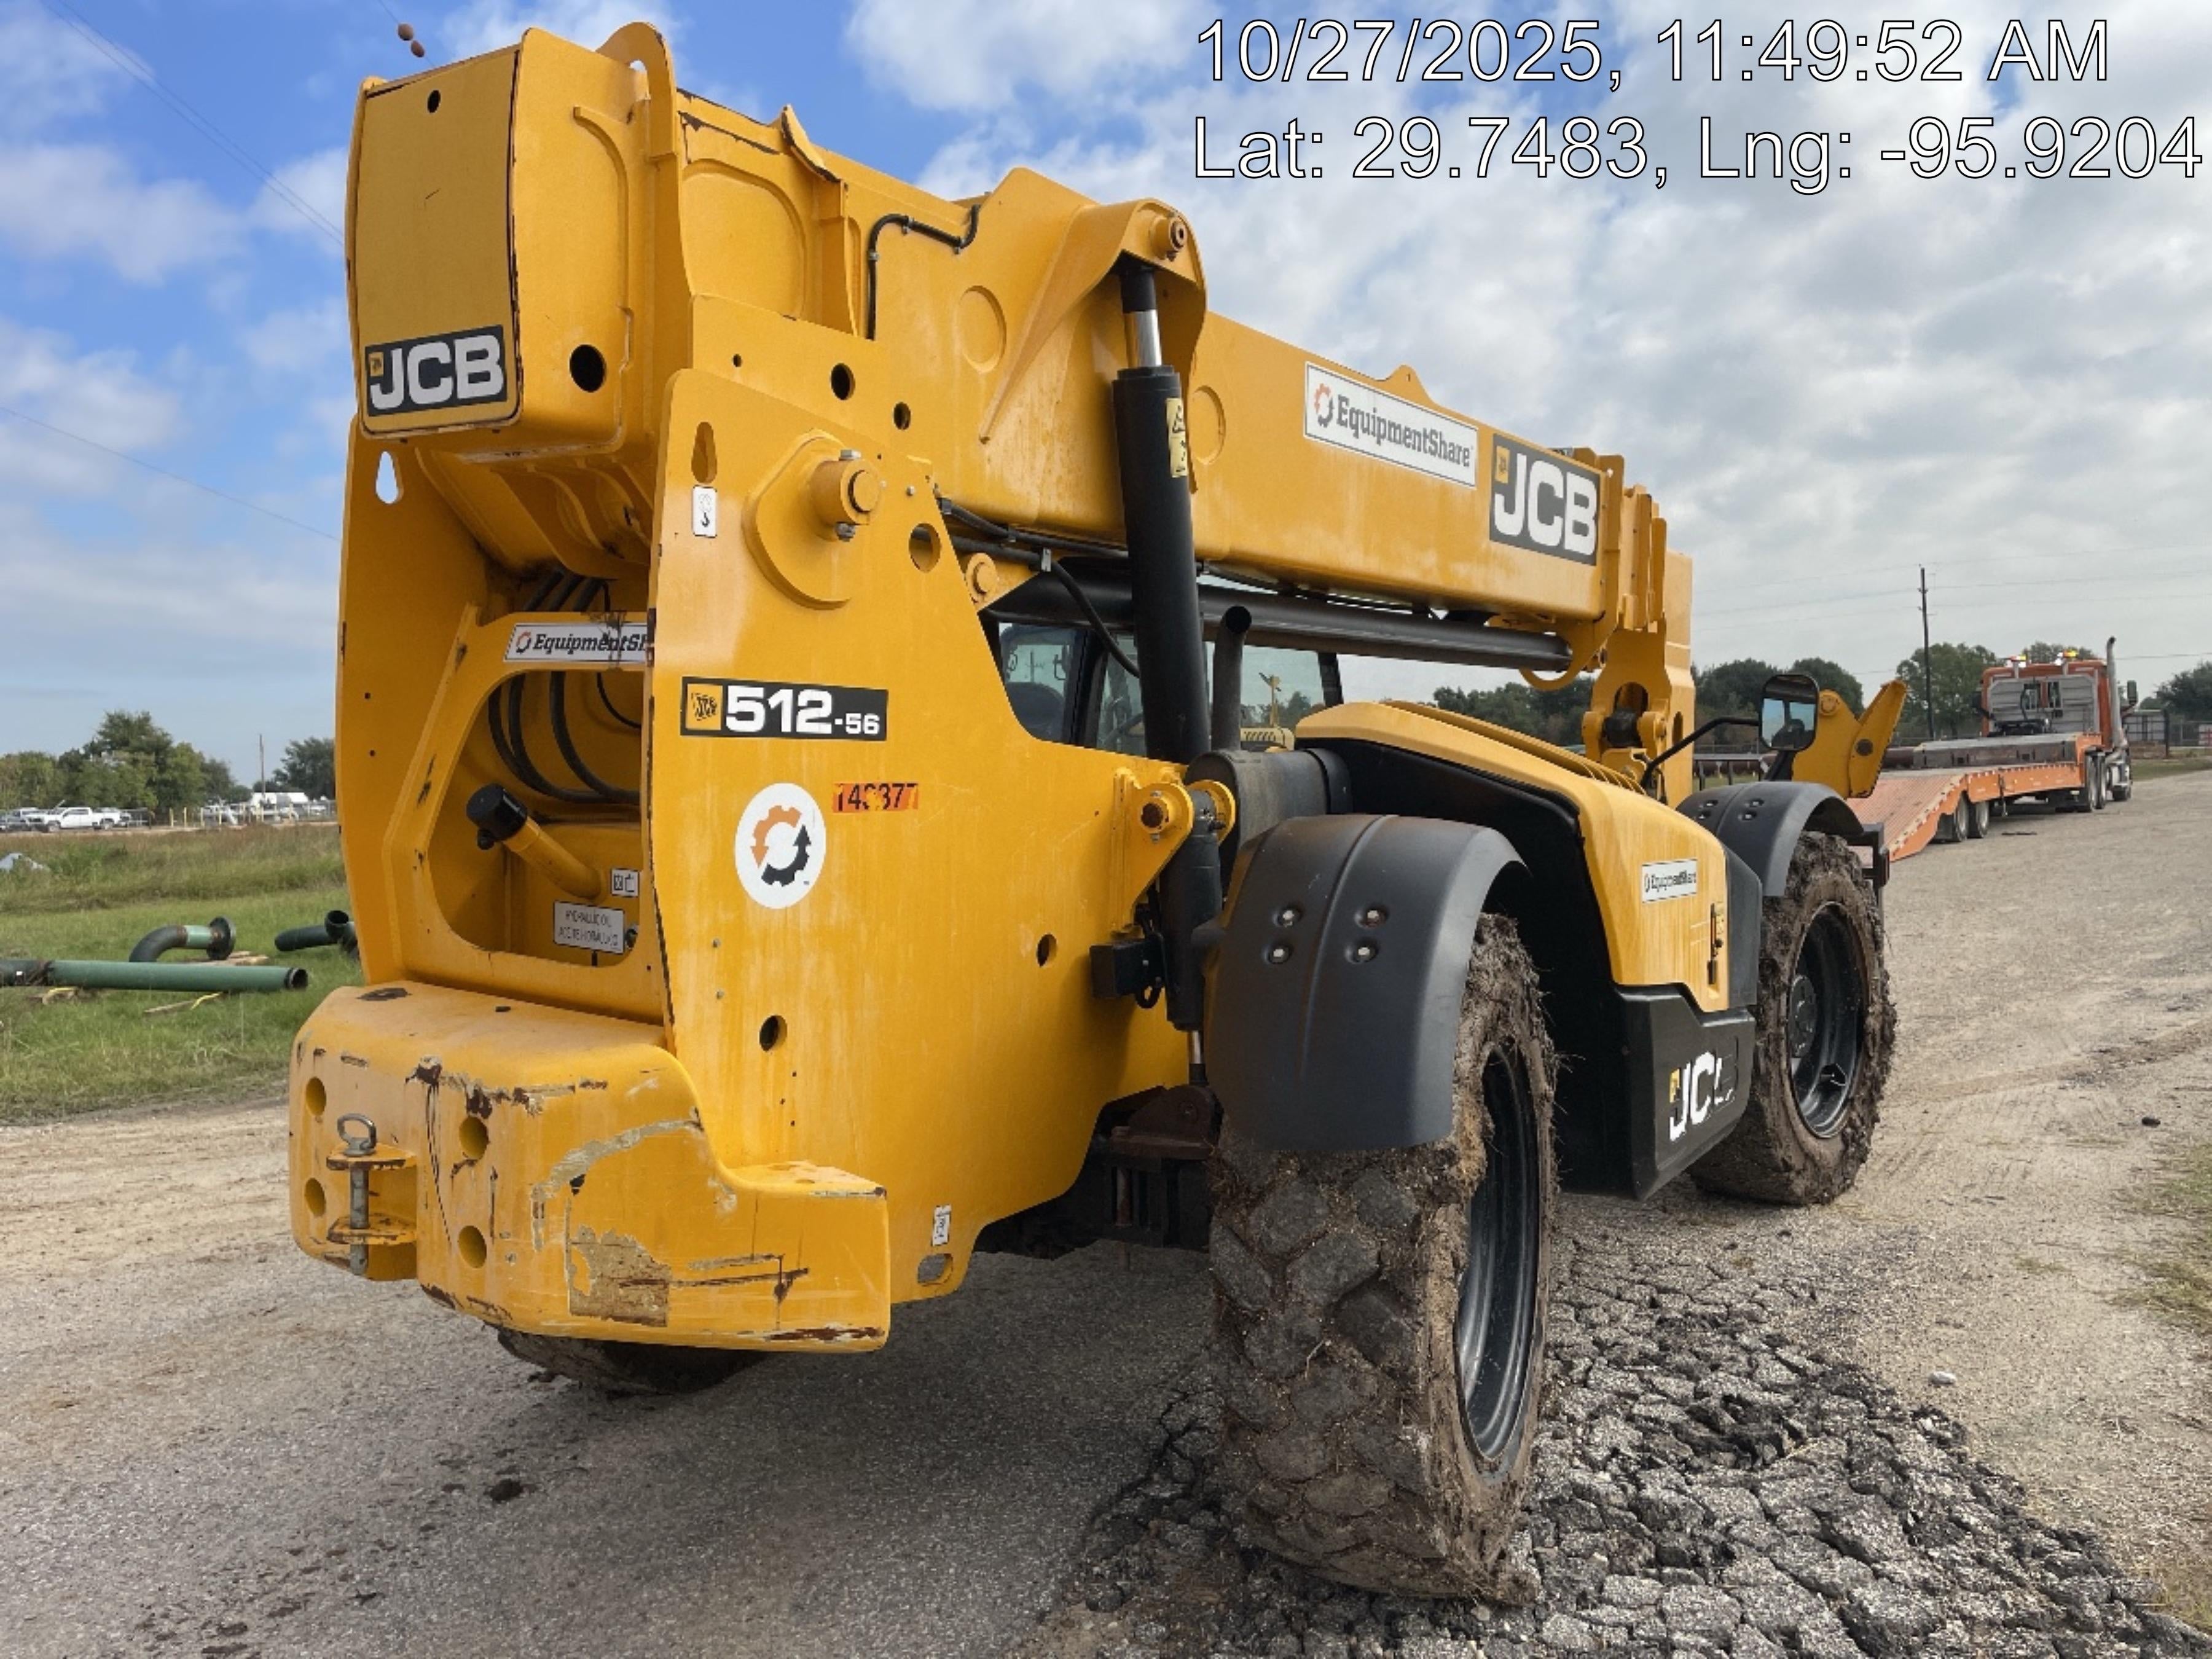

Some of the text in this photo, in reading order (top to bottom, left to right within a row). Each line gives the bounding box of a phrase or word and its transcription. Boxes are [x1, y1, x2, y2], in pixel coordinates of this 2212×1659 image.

[370, 334, 504, 410] JCB
[1336, 394, 1470, 467] EquipmentShare
[1494, 452, 1598, 555] JCB
